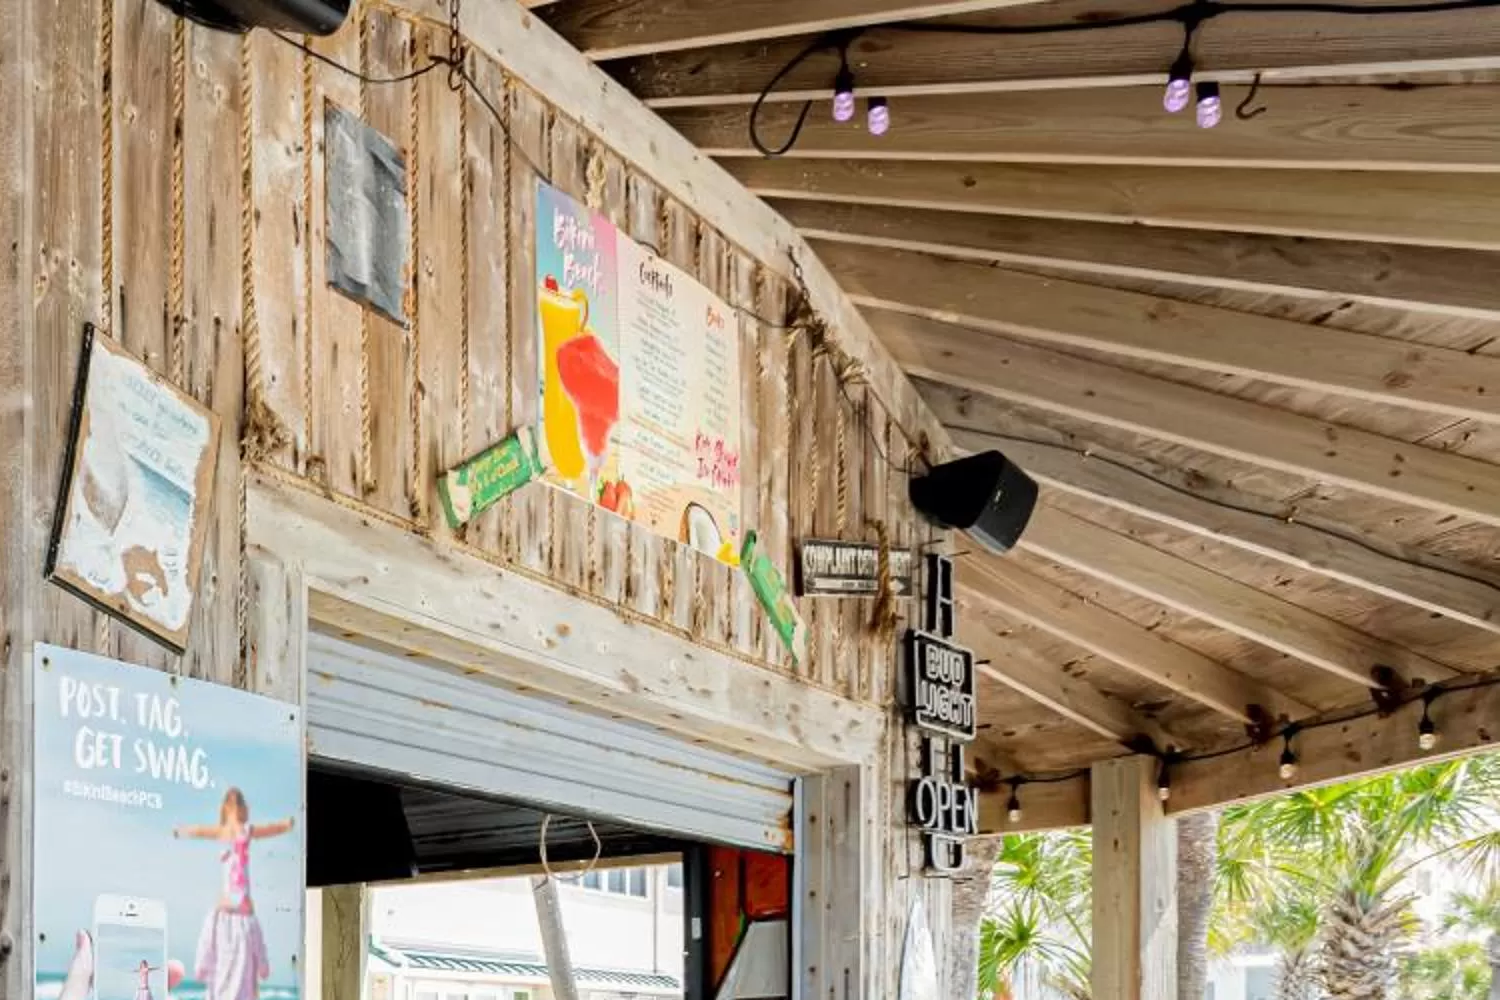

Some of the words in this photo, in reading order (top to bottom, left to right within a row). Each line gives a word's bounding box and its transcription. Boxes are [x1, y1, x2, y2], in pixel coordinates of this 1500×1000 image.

[925, 644, 965, 686] BUD
[59, 675, 127, 725] POST.
[133, 691, 189, 740] TAG.
[921, 681, 973, 727] LIGHT
[75, 725, 123, 769] GET
[133, 737, 216, 790] SWAG.
[917, 779, 979, 835] OPEN
